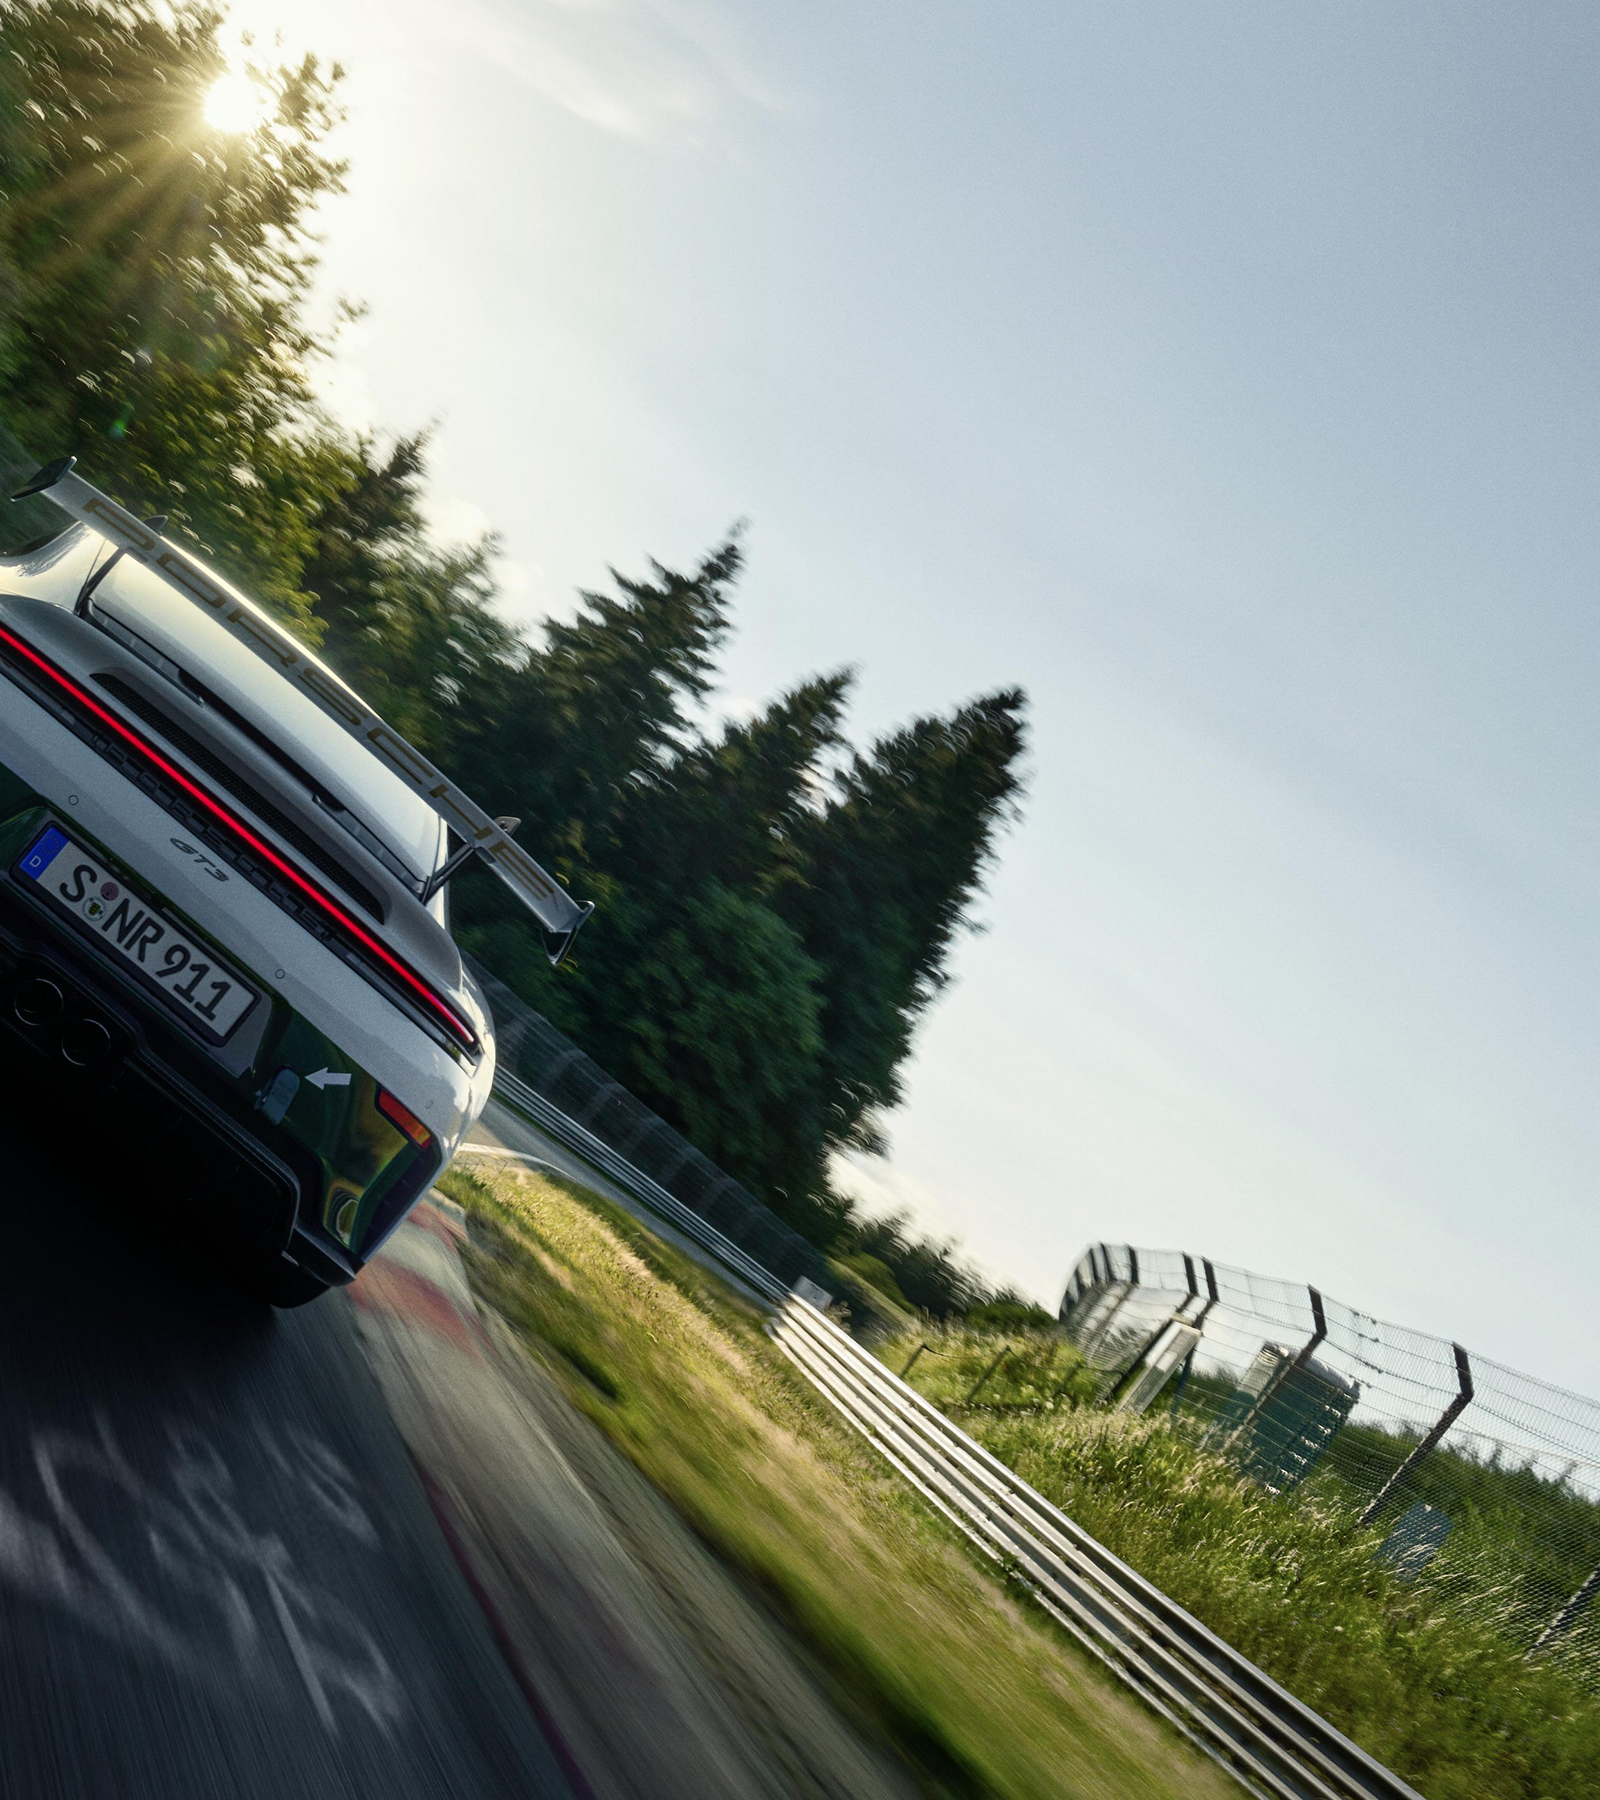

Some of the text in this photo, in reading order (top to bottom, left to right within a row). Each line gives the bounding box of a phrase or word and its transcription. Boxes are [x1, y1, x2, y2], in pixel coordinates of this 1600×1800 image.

[81, 496, 556, 902] PORSCHE
[29, 856, 41, 868] D
[169, 836, 230, 883] GT3
[59, 863, 232, 1021] S NR 911
